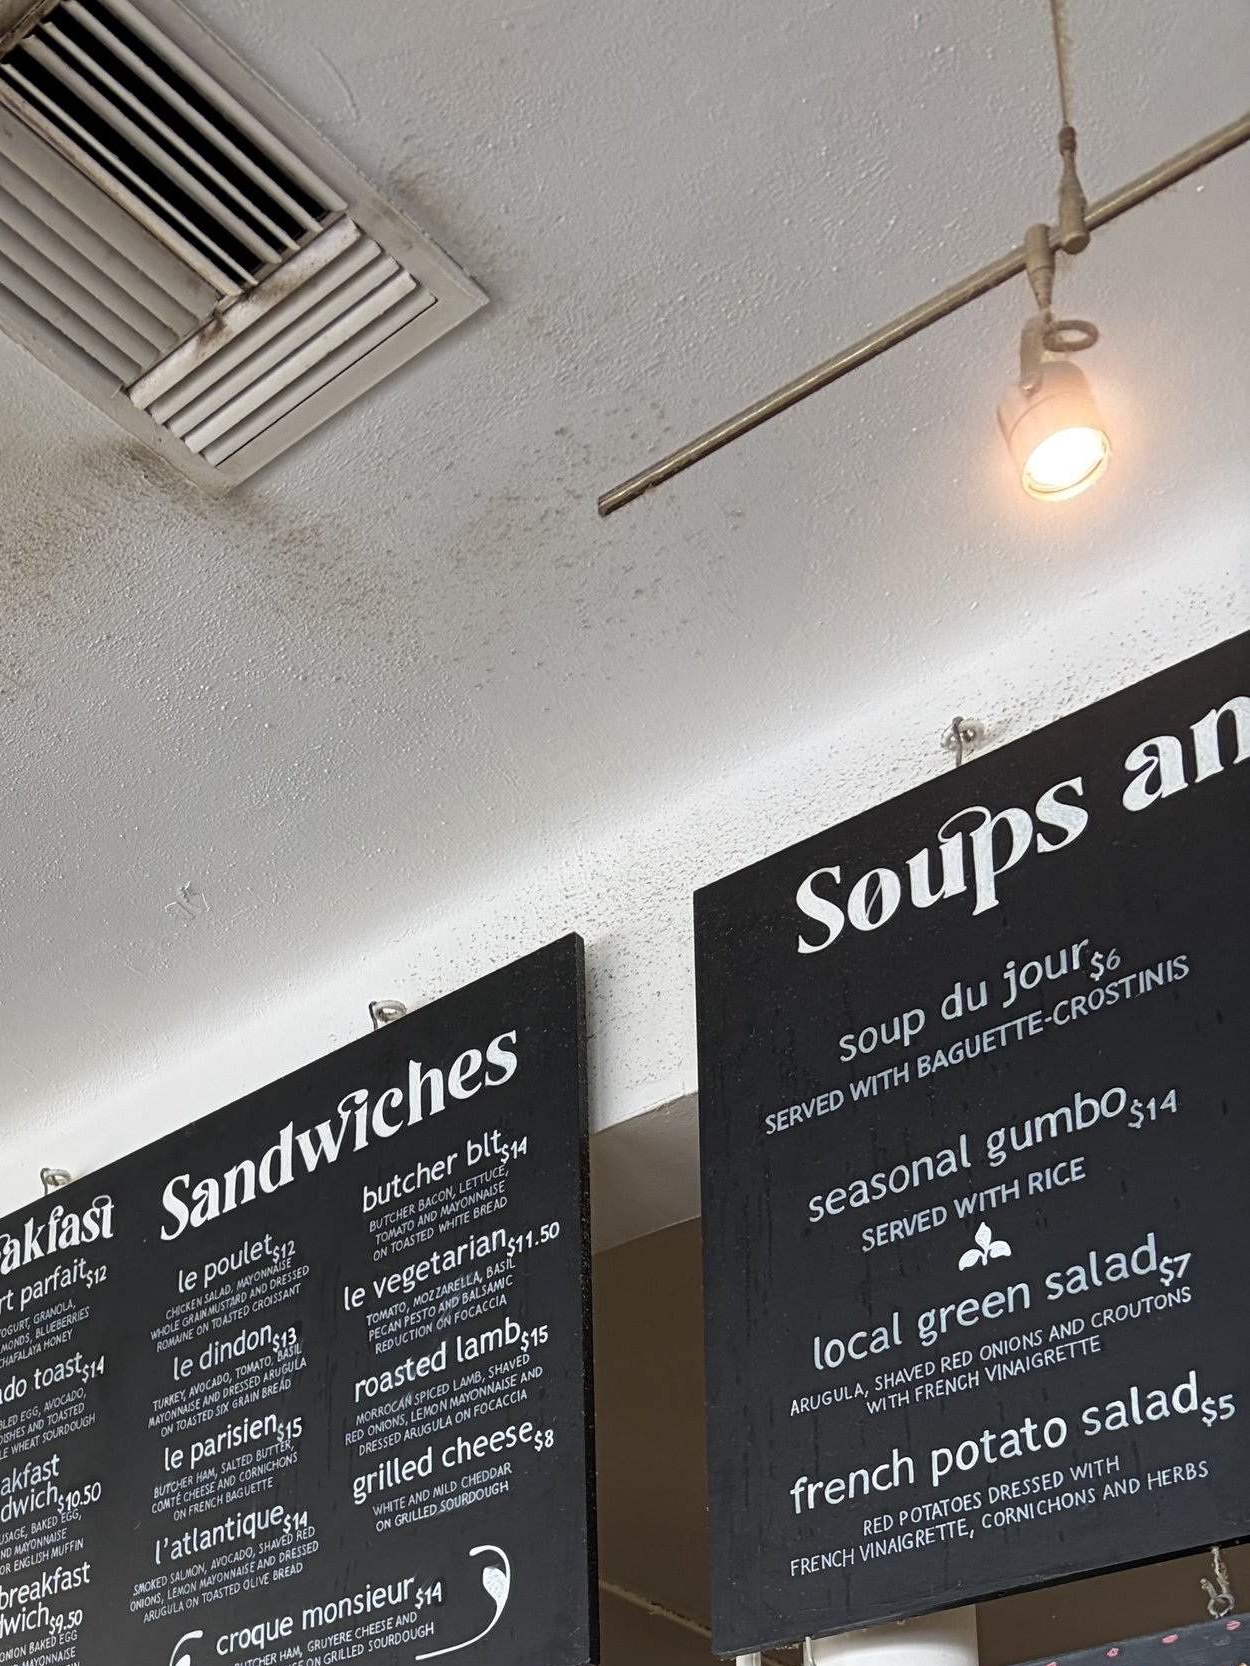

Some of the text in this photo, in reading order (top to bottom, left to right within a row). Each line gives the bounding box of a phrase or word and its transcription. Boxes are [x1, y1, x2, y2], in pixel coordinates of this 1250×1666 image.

[796, 696, 1250, 954] Soups an
[838, 1008, 926, 1063] soup
[940, 982, 988, 1020] du
[1003, 937, 1089, 1007] jour
[765, 955, 1190, 1135] SERVED WITH BAGUETTE-CROSTINIS
[160, 1029, 518, 1241] Sandwiches
[362, 1153, 458, 1213] butcher
[467, 1129, 501, 1166] blt
[807, 1086, 1178, 1223] seasonal gumbo $14
[861, 1156, 1086, 1251] SERVED WITH RICE
[20, 1258, 87, 1311] parfait
[178, 1270, 197, 1293] le
[204, 1233, 272, 1288] poulet
[343, 1286, 365, 1311] le
[373, 1228, 506, 1299] vegetarian
[813, 1313, 902, 1371] local
[918, 1282, 1031, 1347] green
[1045, 1232, 1157, 1300] salad
[34, 1352, 82, 1390] toast
[173, 1355, 193, 1381] le
[199, 1324, 271, 1371] dindon
[354, 1346, 446, 1402] roasted
[456, 1317, 521, 1364] lamb
[790, 1286, 1192, 1417] ARUGULA, SHAVED RED ONIONS AND CROUTONS
[867, 1336, 1101, 1414] WITH FRENCH VINAIGRETTE
[164, 1447, 183, 1471] le
[190, 1414, 277, 1469] parisien
[352, 1451, 433, 1504] grilled
[442, 1420, 533, 1467] cheese
[789, 1448, 915, 1514] french
[931, 1417, 1067, 1487] potato
[1082, 1370, 1200, 1436] salad
[373, 1463, 512, 1516] WHITE AND MILD CHEDDAR
[376, 1480, 509, 1532] ON GRILLED SOURDOUGH
[790, 1460, 1209, 1577] FRENCH VINAIGRETTE, CORNICHONS AND HERBS
[863, 1455, 1120, 1536] RED POTATOES DRESSED WITH
[216, 1614, 293, 1658] croque
[302, 1577, 414, 1631] monsieur
